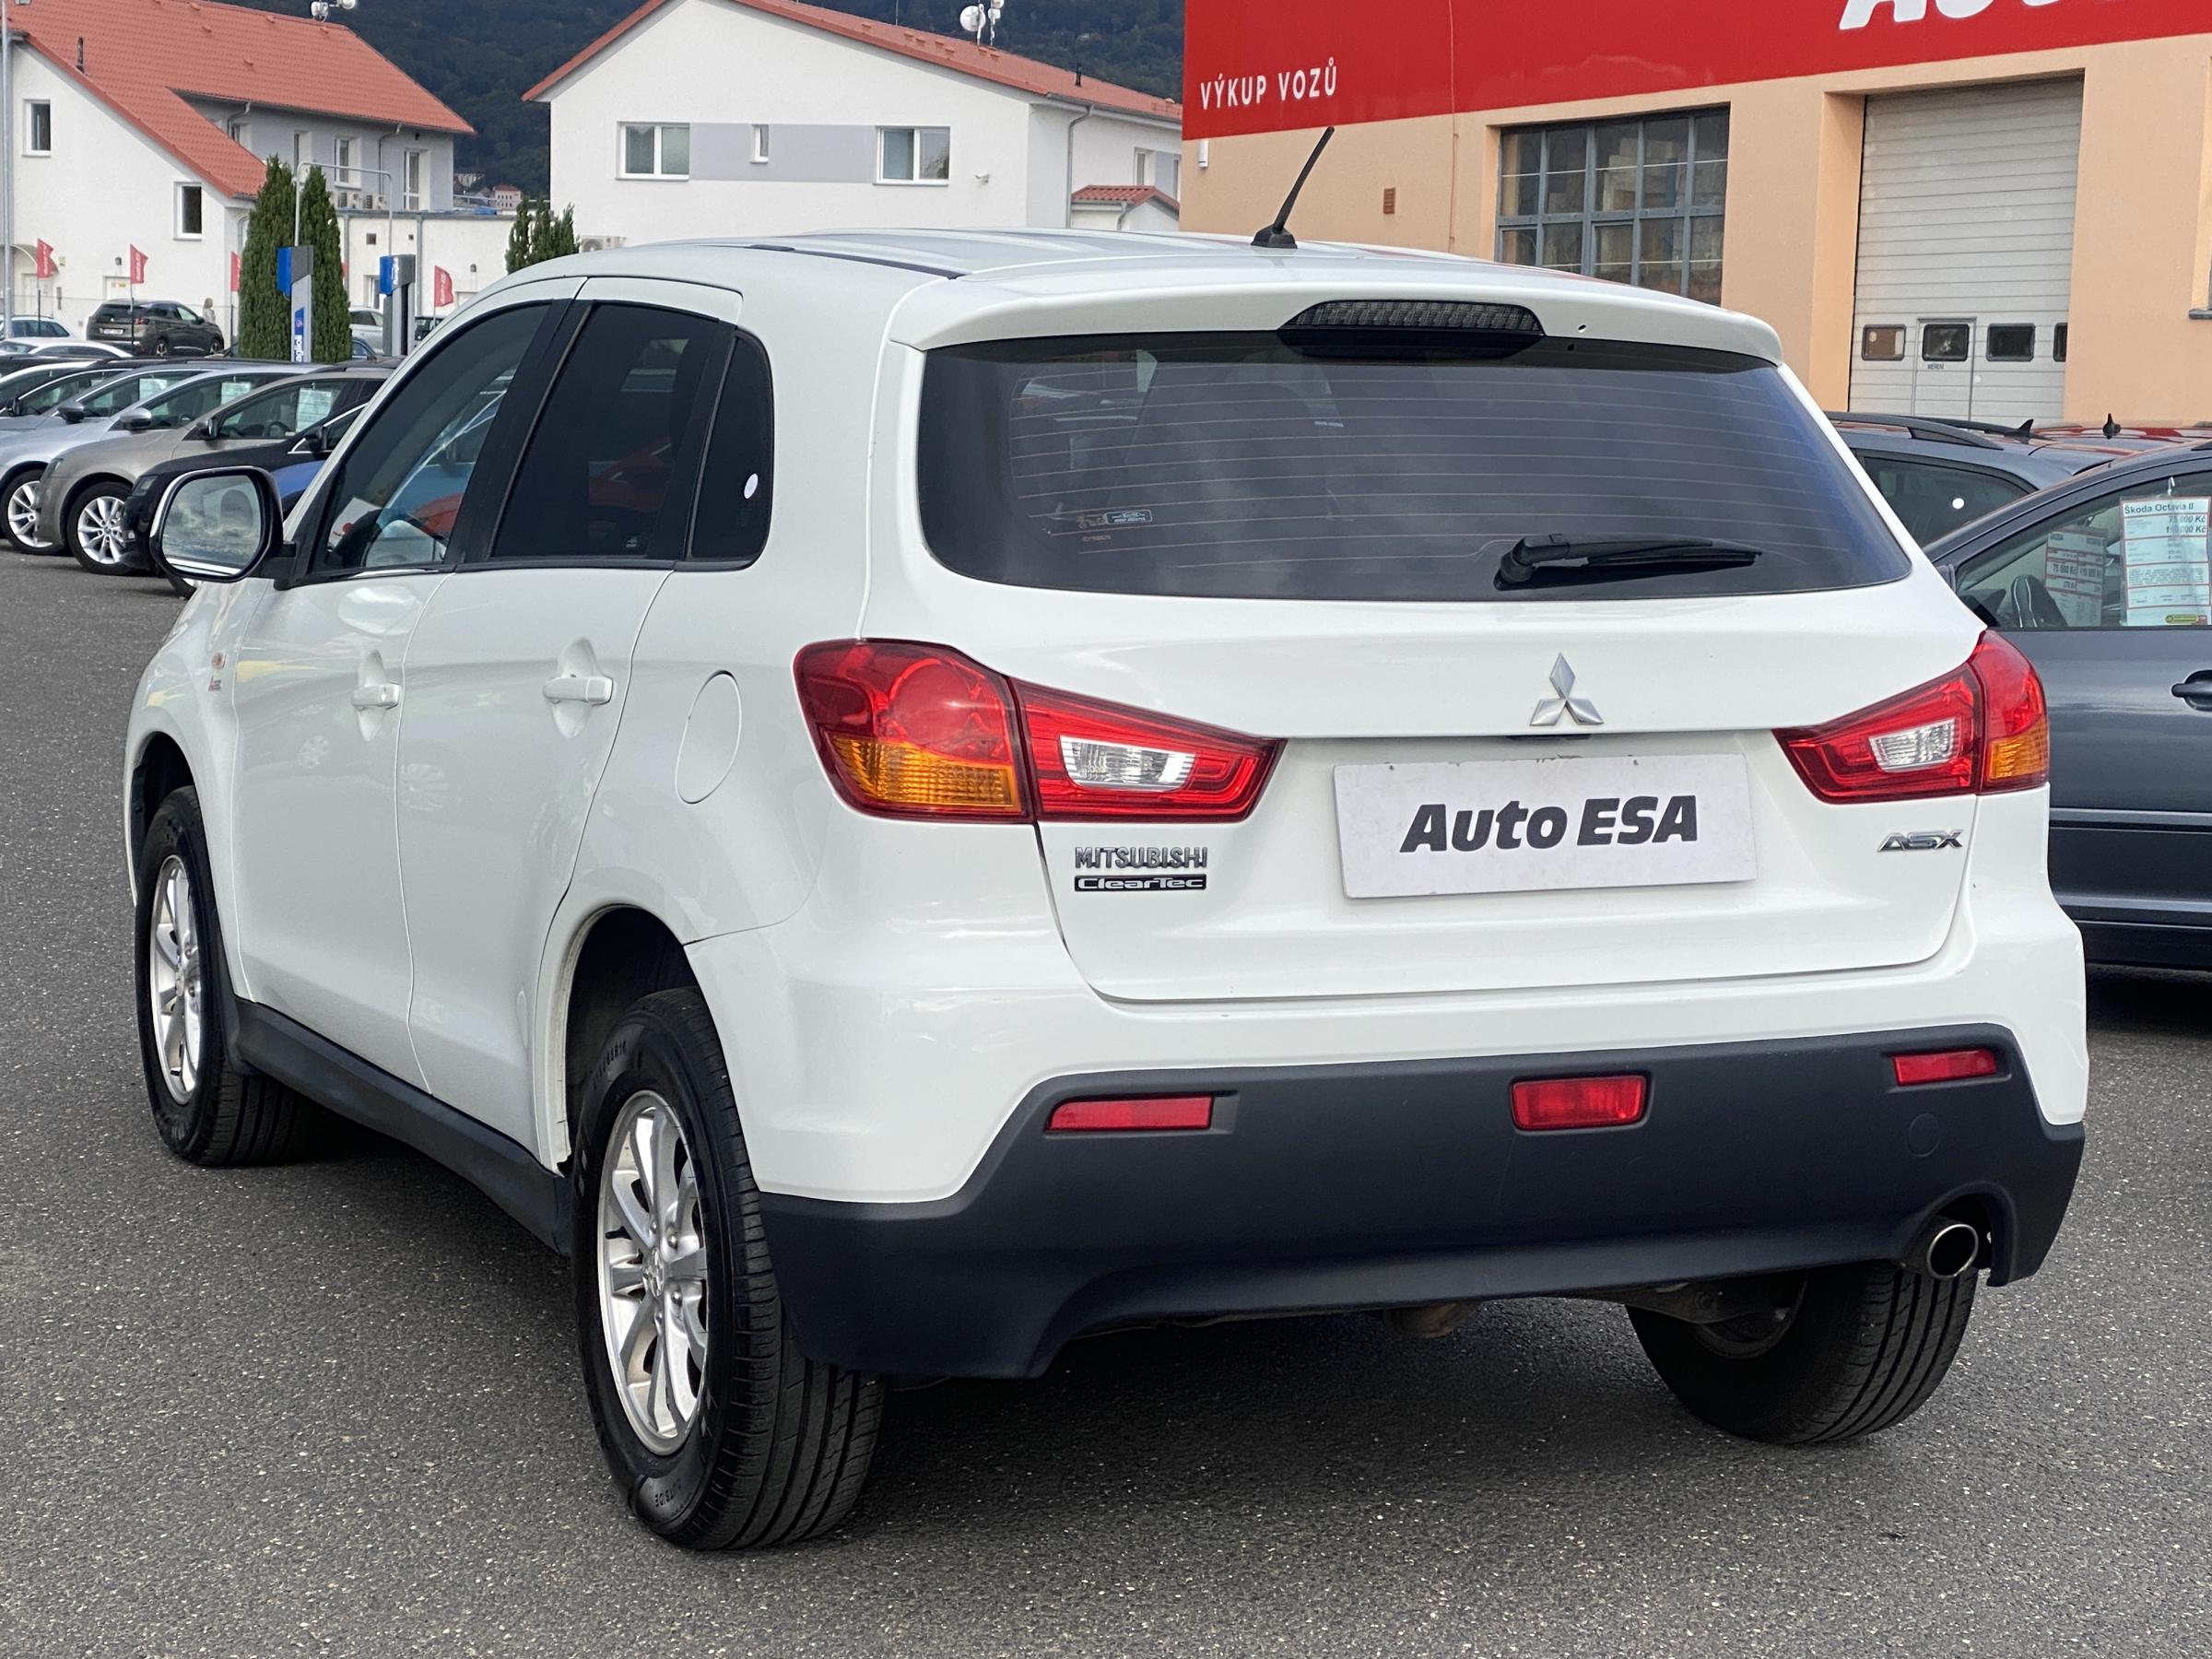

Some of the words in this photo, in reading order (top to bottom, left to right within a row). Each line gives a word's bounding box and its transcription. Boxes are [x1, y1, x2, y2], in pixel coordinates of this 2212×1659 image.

[1200, 73, 1266, 110] VÝKUP
[1278, 56, 1336, 101] VOZŮ
[2124, 505, 2152, 514] Škoda
[1399, 800, 1568, 853] Auto
[1577, 794, 1698, 846] ESA
[1877, 829, 1963, 853] ASX
[1075, 846, 1207, 869] MITSUBISHI
[1077, 877, 1204, 889] ClearTec
